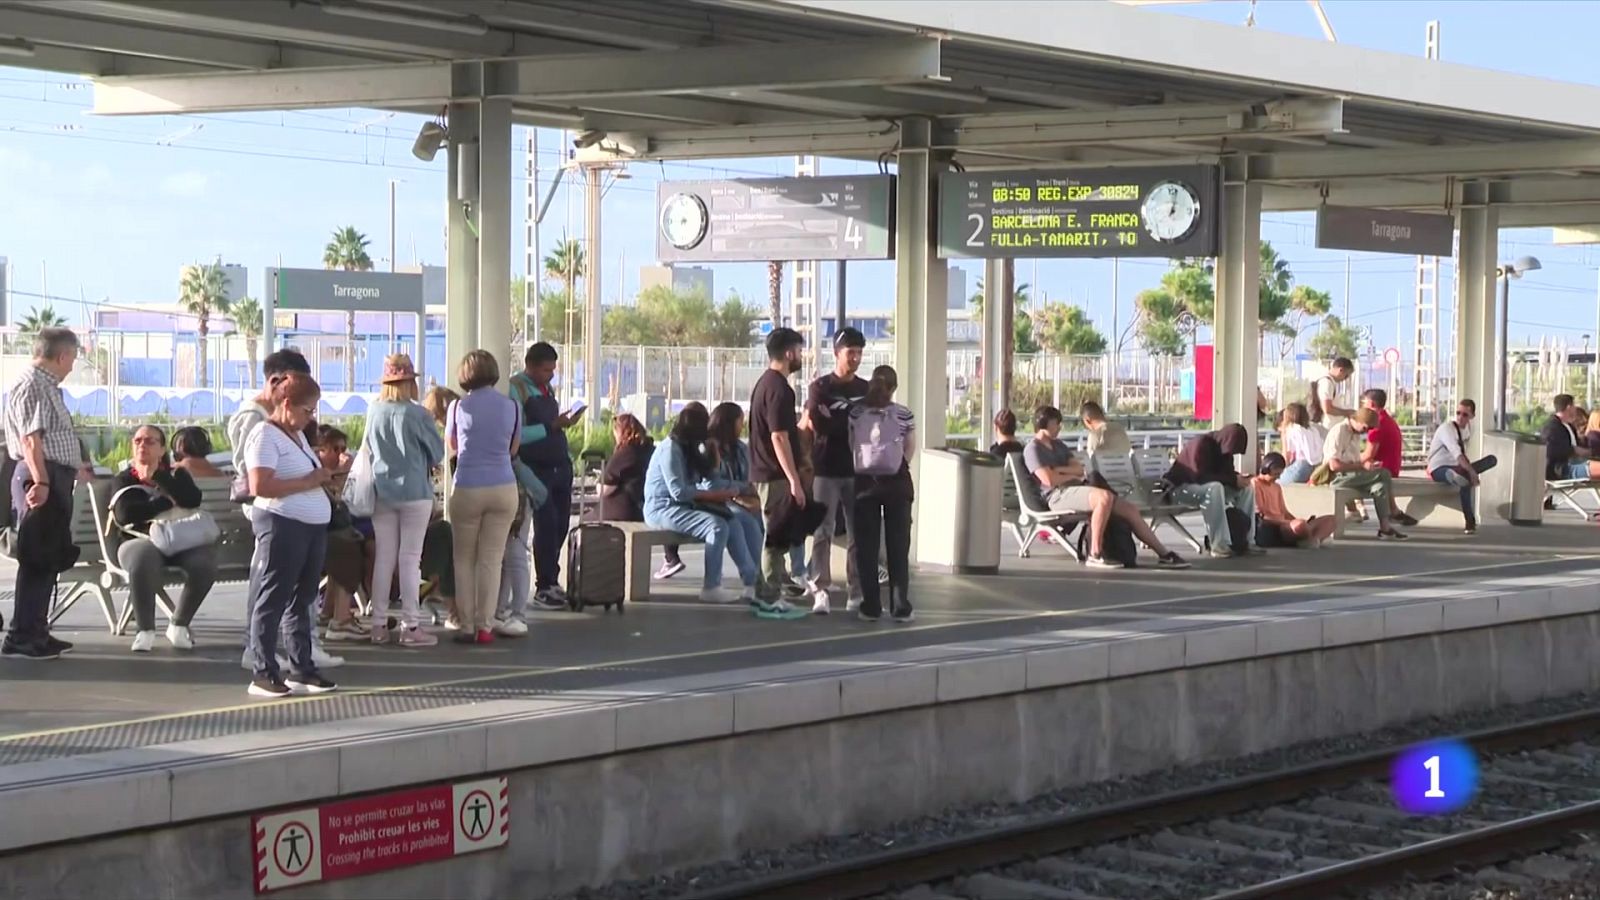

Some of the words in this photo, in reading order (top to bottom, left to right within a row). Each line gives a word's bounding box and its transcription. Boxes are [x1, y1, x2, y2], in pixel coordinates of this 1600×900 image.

[992, 187, 1031, 203] 08:50
[1037, 185, 1092, 202] REG.EXP
[1098, 184, 1139, 200] 30824
[844, 216, 863, 250] 4
[966, 213, 985, 247] 2
[992, 214, 1061, 229] BARCELONA
[1067, 214, 1081, 228] E.
[1091, 212, 1139, 228] FRANCA
[1371, 220, 1411, 241] Tarragona
[332, 284, 380, 300] Tarragona
[328, 815, 341, 828] No
[343, 815, 353, 827] se
[355, 809, 388, 827] permite
[389, 805, 414, 818] cruzar
[416, 800, 429, 813] las
[339, 828, 376, 846] Prohibit
[378, 824, 406, 839] creuar
[408, 819, 421, 833] les
[327, 851, 361, 867] Crossing
[363, 846, 376, 860] the
[377, 841, 401, 858] tracks
[402, 840, 410, 853] is
[410, 831, 450, 854] prohibited
